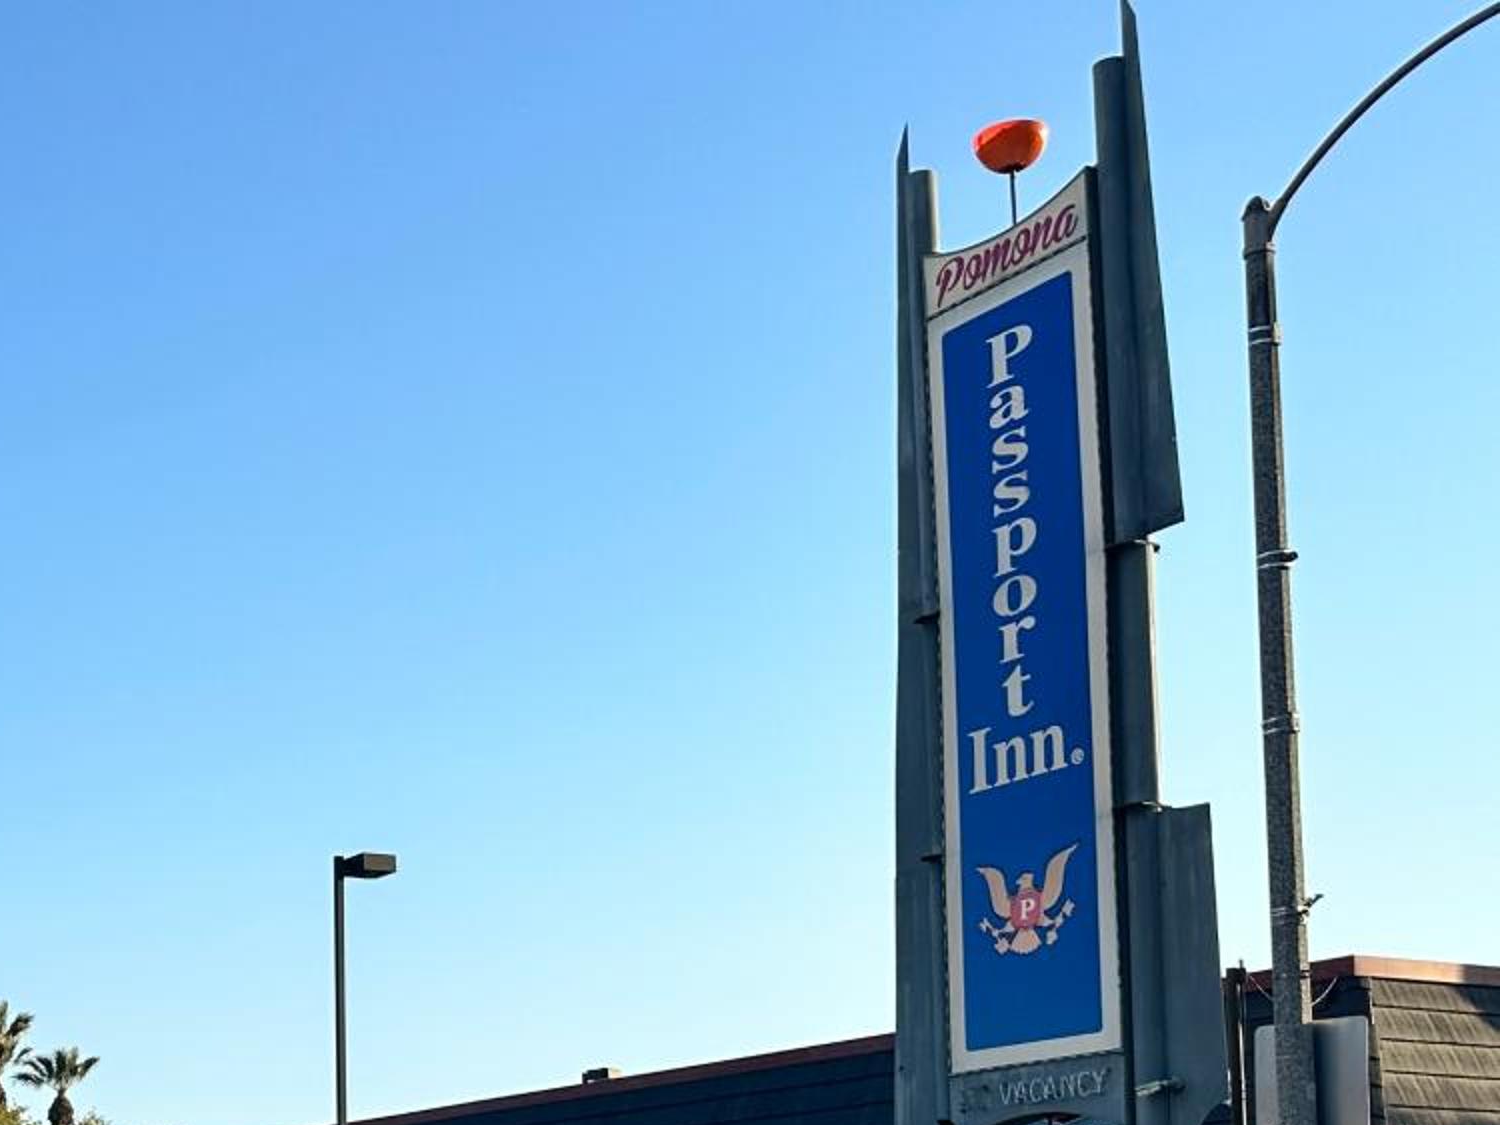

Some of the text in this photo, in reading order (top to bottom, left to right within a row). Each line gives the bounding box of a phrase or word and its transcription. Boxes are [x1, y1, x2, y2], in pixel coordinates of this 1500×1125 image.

[935, 203, 1079, 308] Pomona
[985, 323, 1039, 718] Passport
[1020, 898, 1036, 921] P
[999, 1067, 1108, 1105] VACANCY
